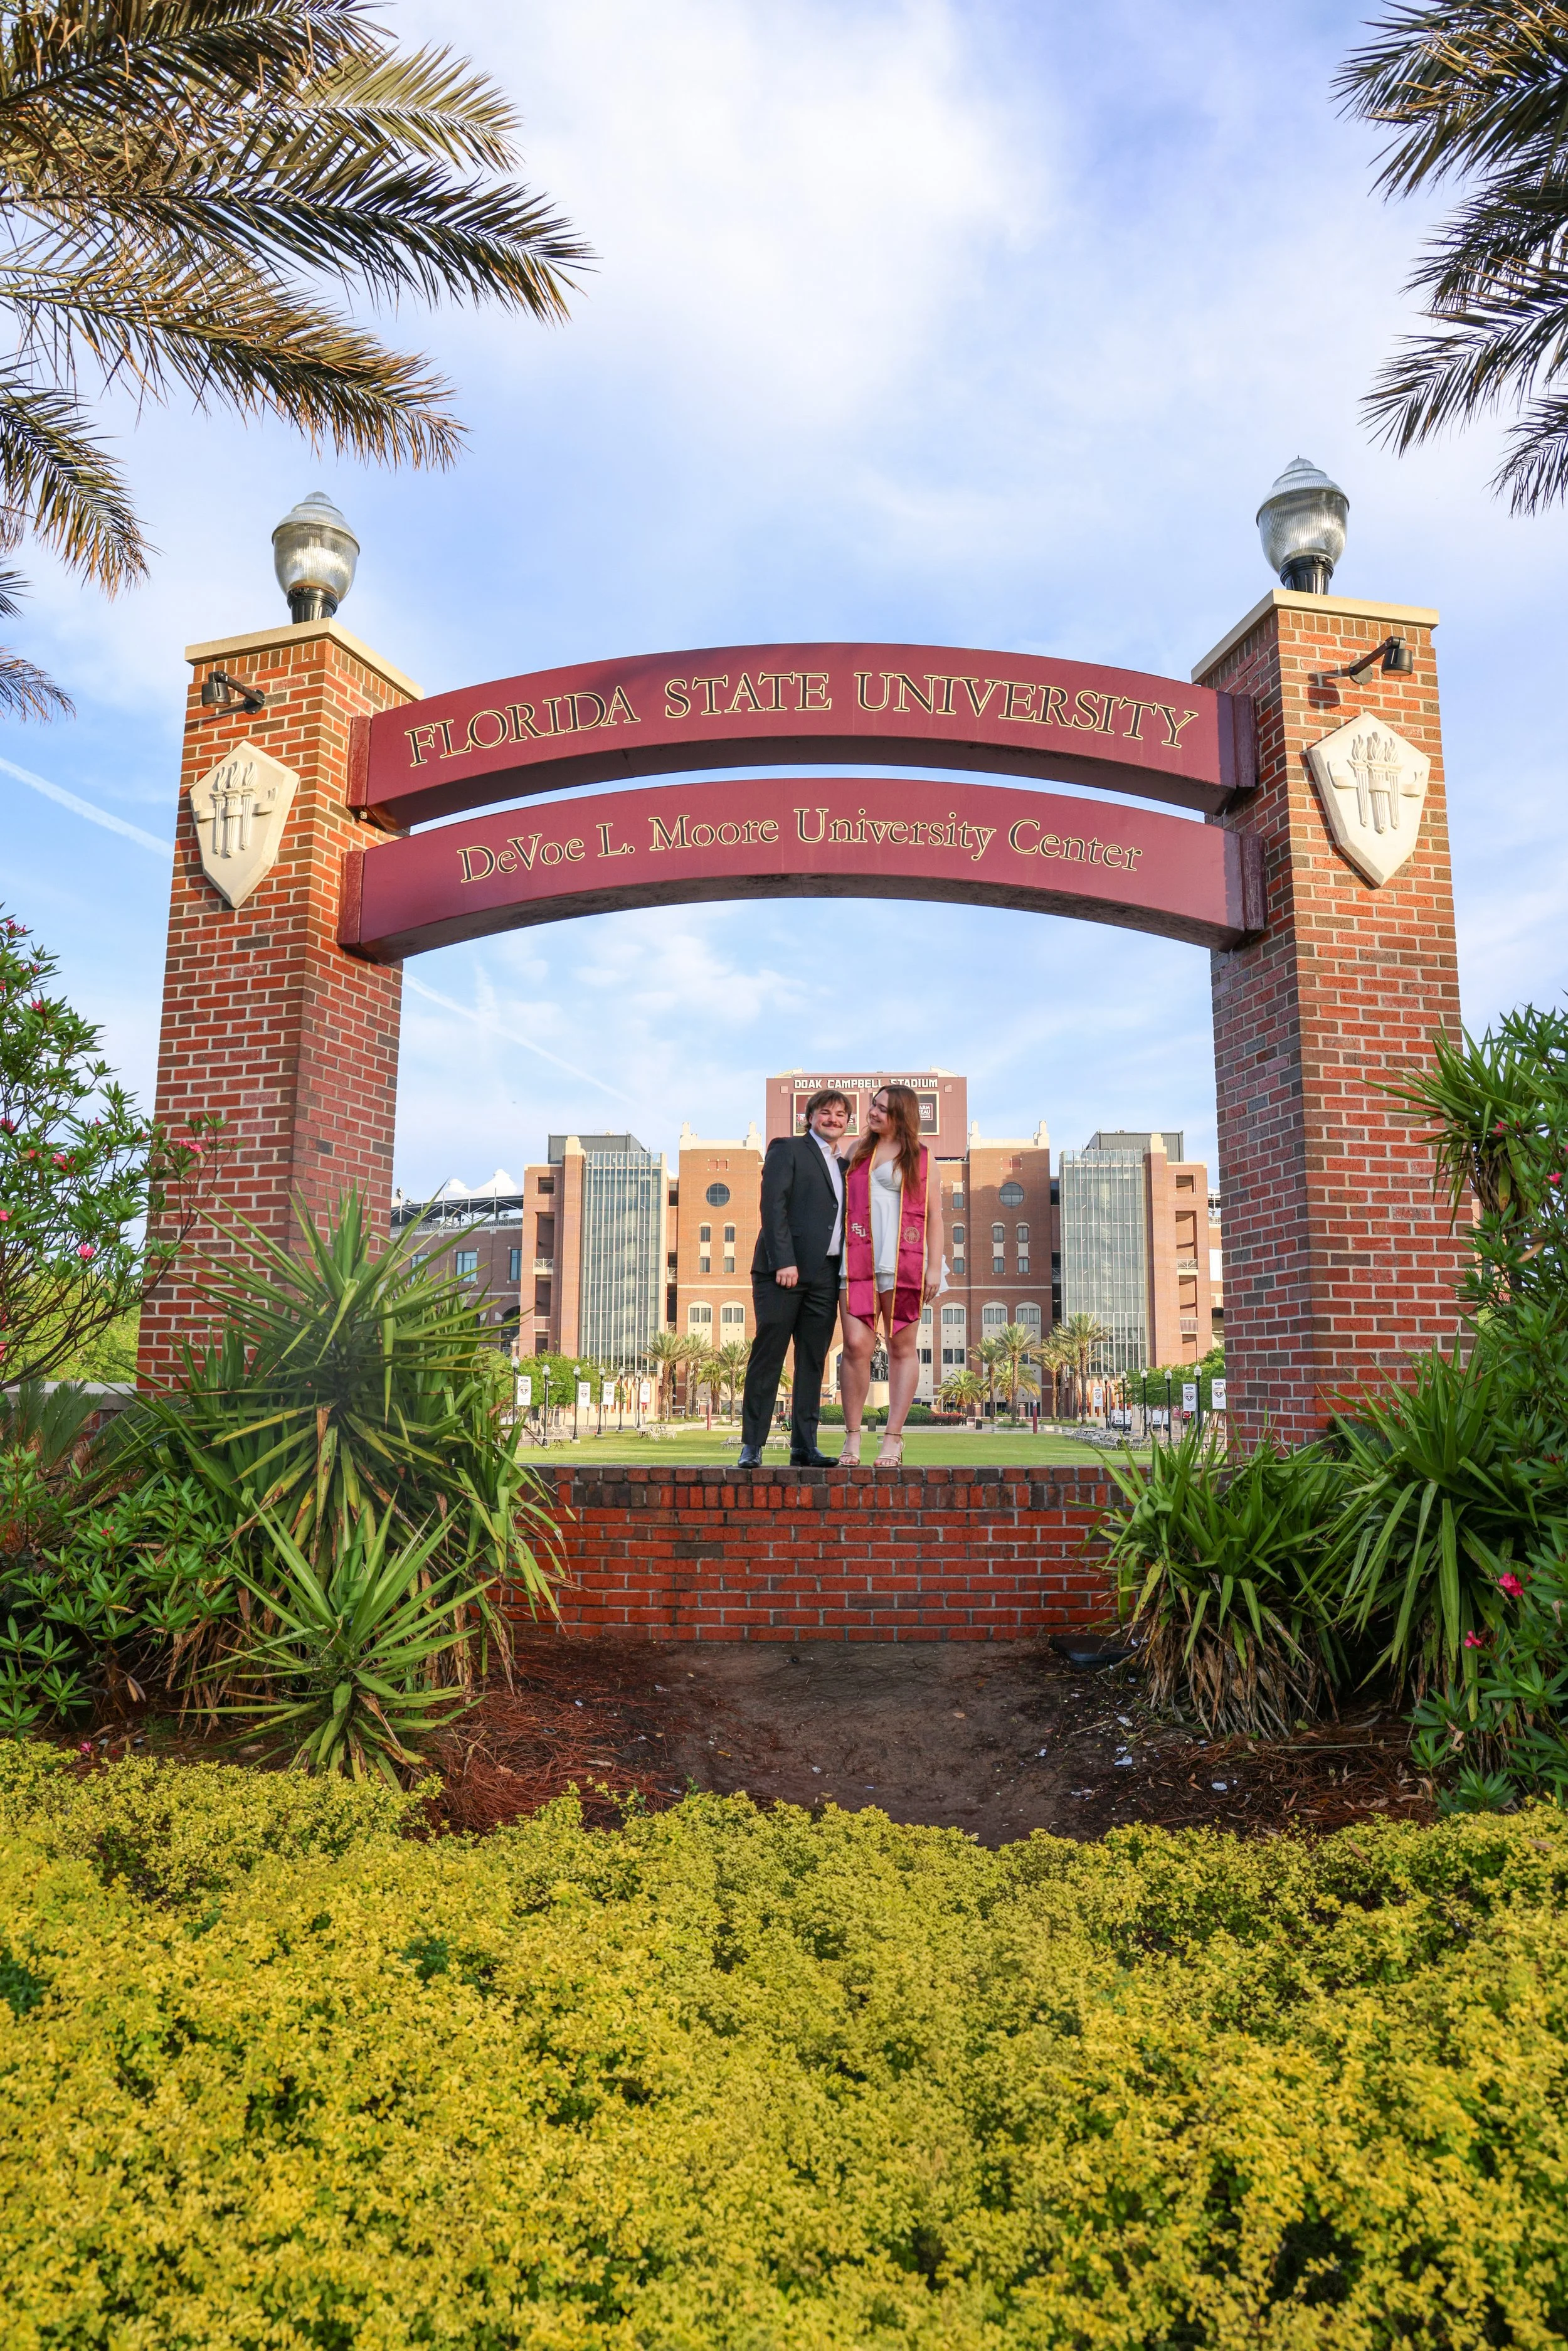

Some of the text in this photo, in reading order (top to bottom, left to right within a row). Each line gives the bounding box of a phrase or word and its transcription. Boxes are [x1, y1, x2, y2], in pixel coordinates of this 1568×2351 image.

[405, 672, 1199, 767] FLORIDA STATE UNIVERSITY
[456, 808, 1143, 883] DeVoe L. Moore University Center
[794, 1078, 938, 1089] DOAK CAMPBELL STADIUM
[851, 1223, 866, 1237] FSU
